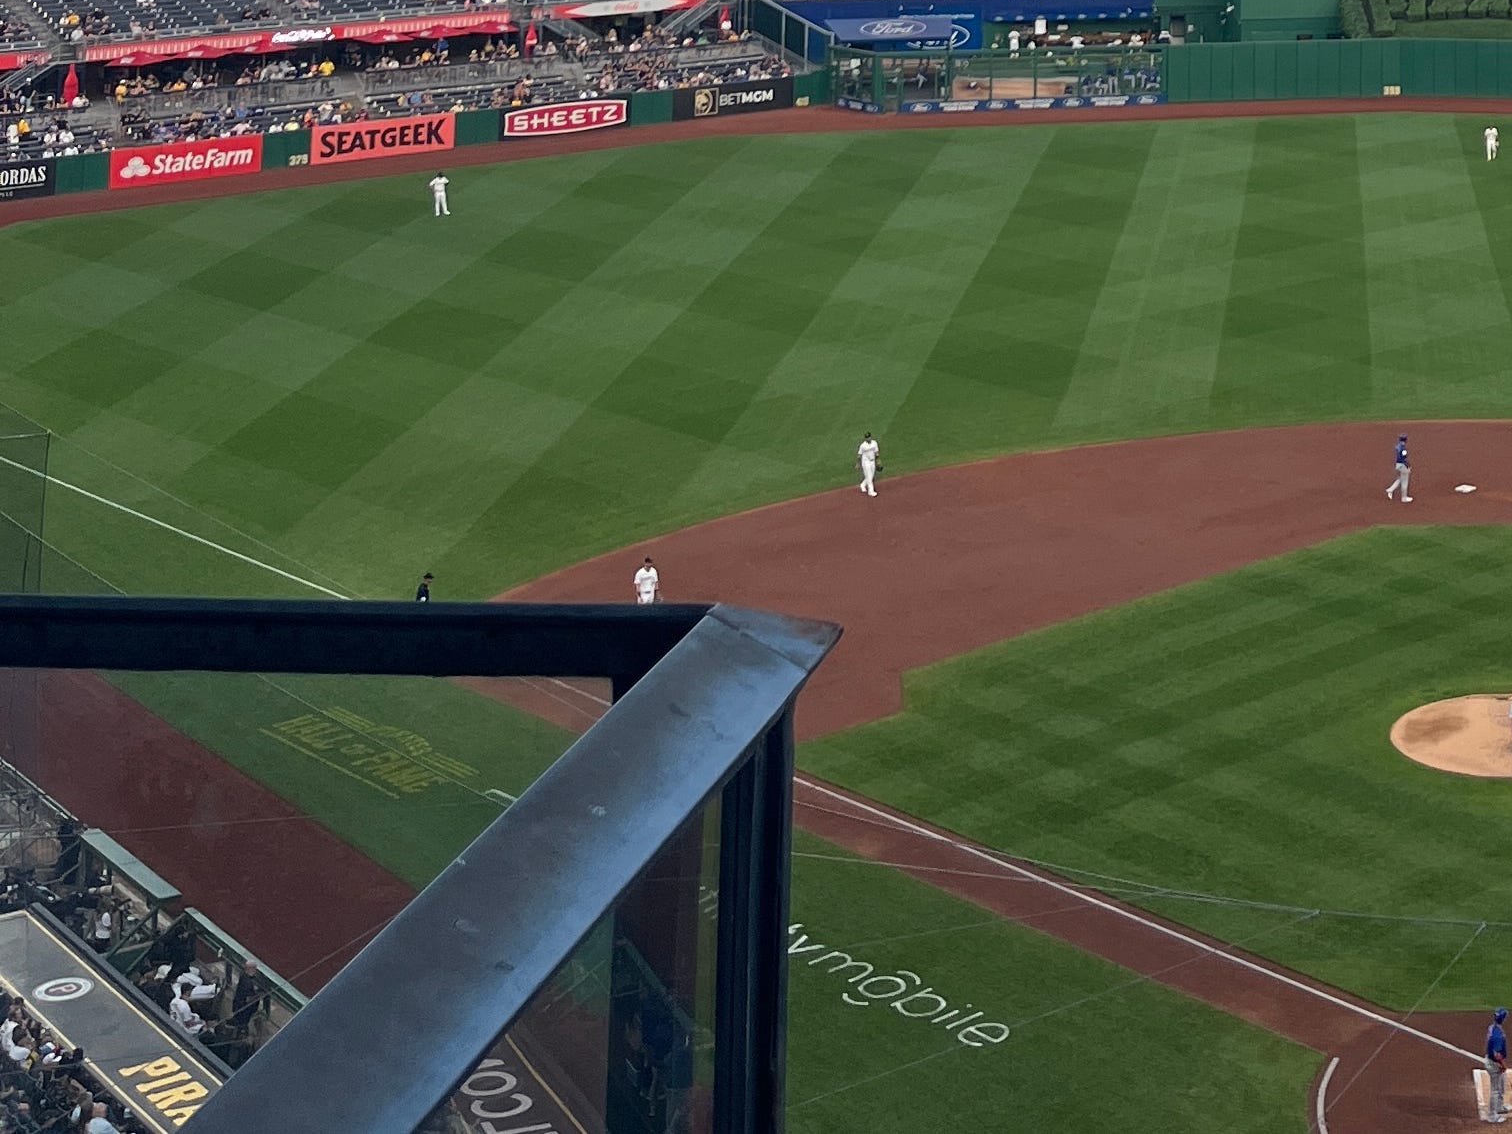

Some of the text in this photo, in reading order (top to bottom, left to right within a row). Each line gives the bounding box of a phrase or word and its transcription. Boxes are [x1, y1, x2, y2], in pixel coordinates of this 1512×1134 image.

[320, 117, 447, 158] SEATGEEK
[513, 105, 618, 131] SHEETZ
[808, 951, 1010, 1047] mobile
